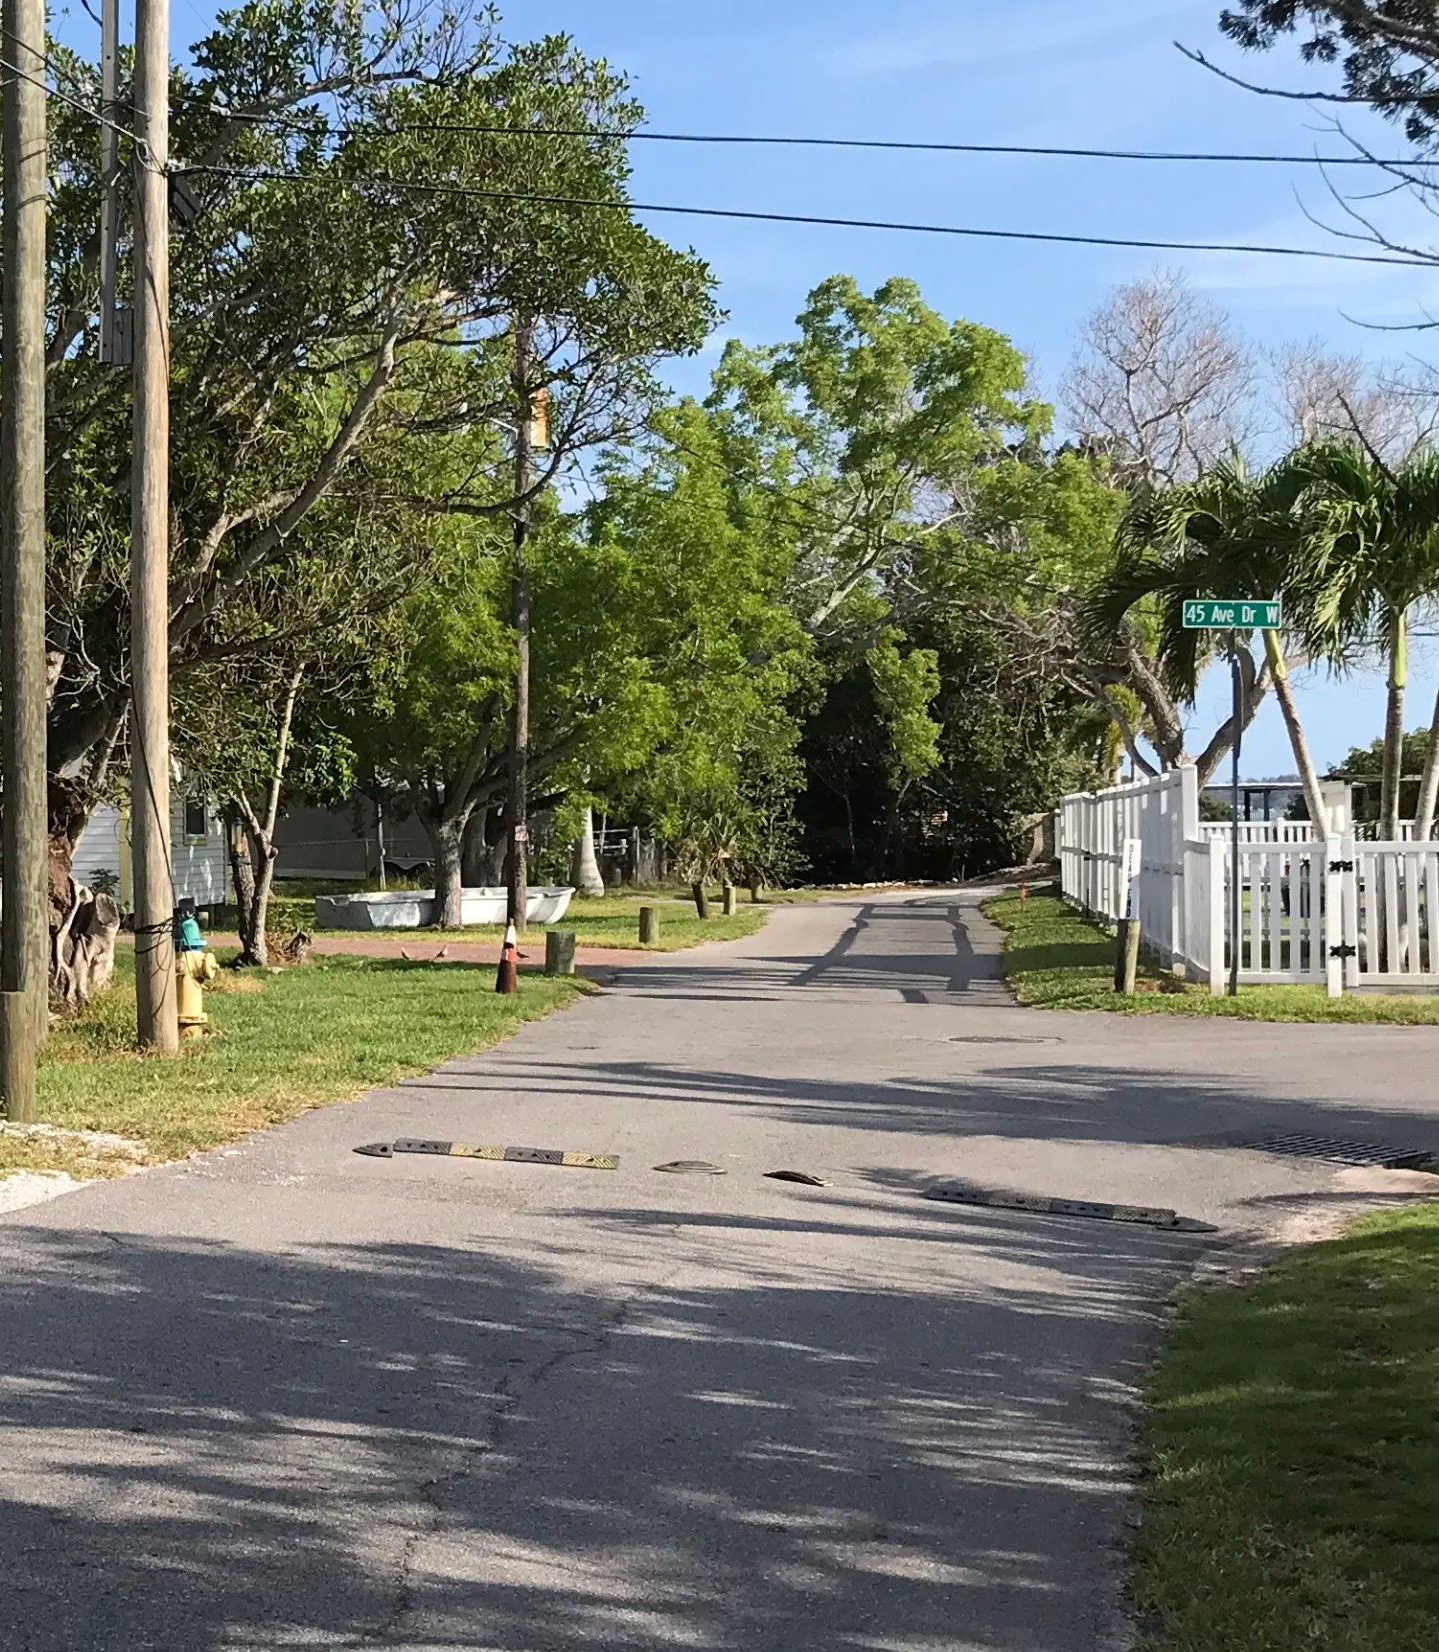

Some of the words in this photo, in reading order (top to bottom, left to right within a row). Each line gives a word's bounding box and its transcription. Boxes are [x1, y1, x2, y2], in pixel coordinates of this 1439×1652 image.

[1186, 605, 1205, 623] 45
[1211, 605, 1235, 623] Ave
[1242, 606, 1257, 623] Dr
[1266, 606, 1278, 623] W
